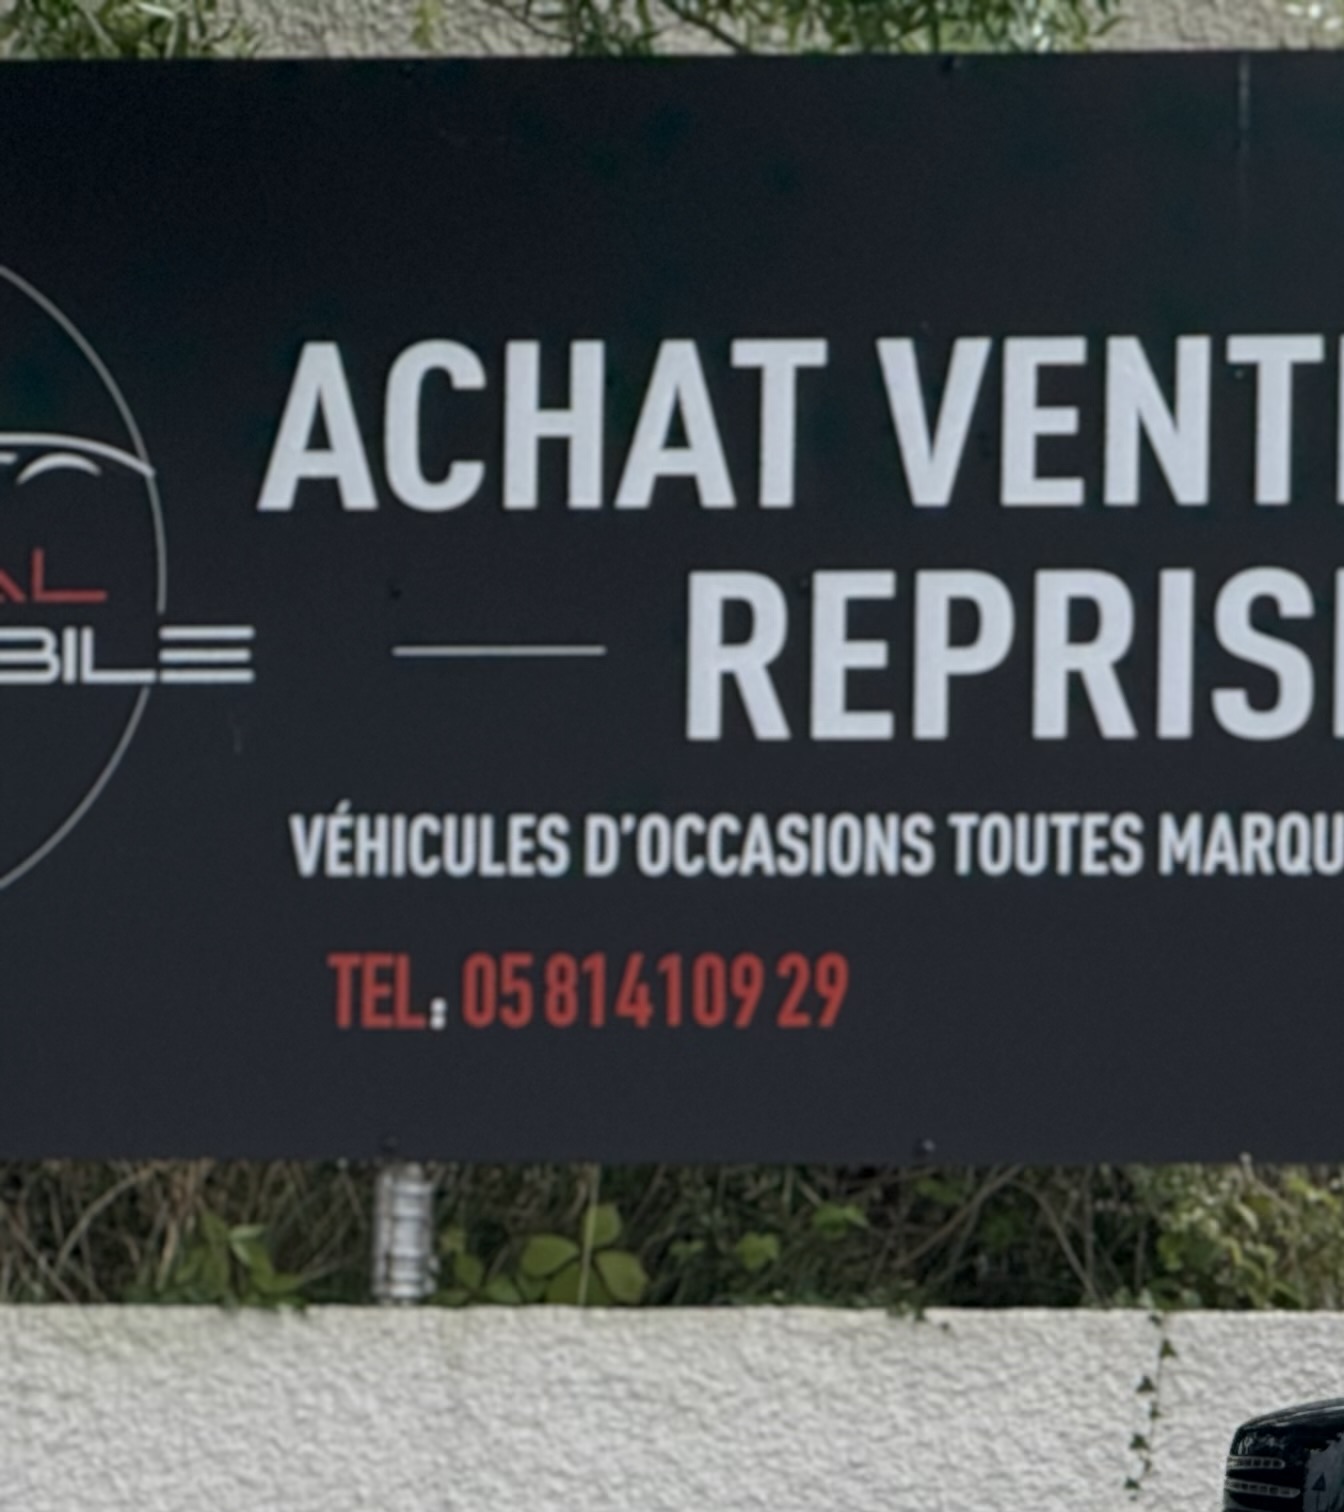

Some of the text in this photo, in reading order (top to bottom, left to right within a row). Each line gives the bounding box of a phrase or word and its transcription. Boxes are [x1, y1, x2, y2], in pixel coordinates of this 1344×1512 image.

[257, 338, 828, 511] ACHAT
[290, 800, 570, 877] VÉHICULES
[948, 812, 1145, 876] TOUTES
